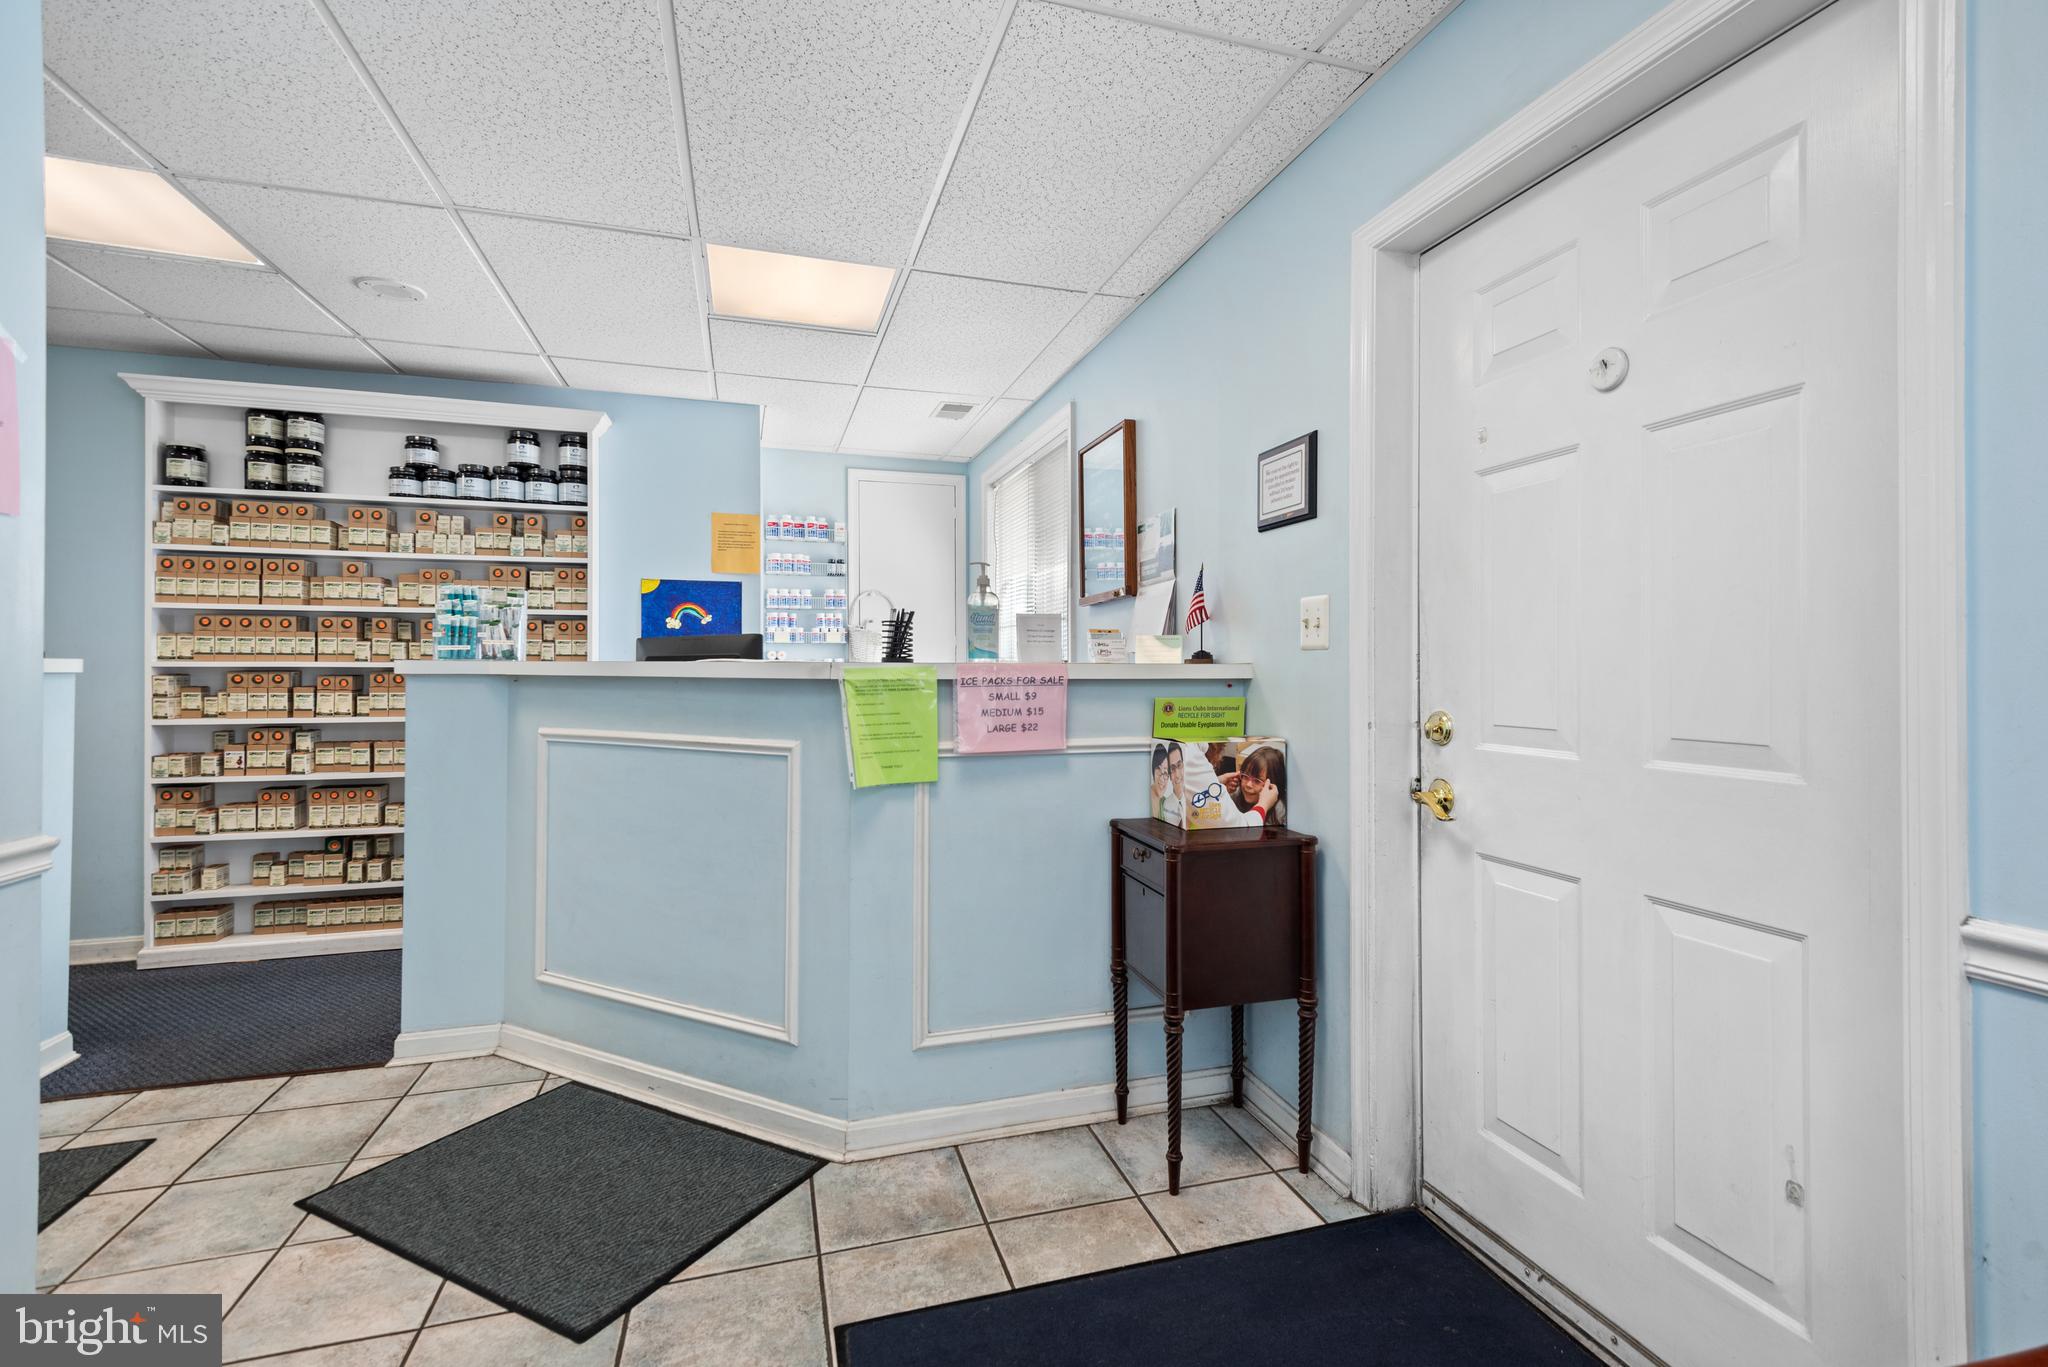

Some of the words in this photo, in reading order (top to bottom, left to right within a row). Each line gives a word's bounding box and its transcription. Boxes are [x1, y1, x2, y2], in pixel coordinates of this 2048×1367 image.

[960, 677, 978, 686] ICE
[982, 676, 1013, 686] PACKS
[1016, 676, 1036, 685] FOR
[1040, 675, 1065, 685] SALE
[988, 692, 1020, 701] SMALL
[1024, 691, 1037, 700] $9
[981, 708, 1022, 717] MEDIUM
[1026, 707, 1044, 716] $15
[986, 723, 1017, 733] LARGE
[1021, 723, 1039, 732] $22
[1197, 721, 1225, 729] Eyeglasses
